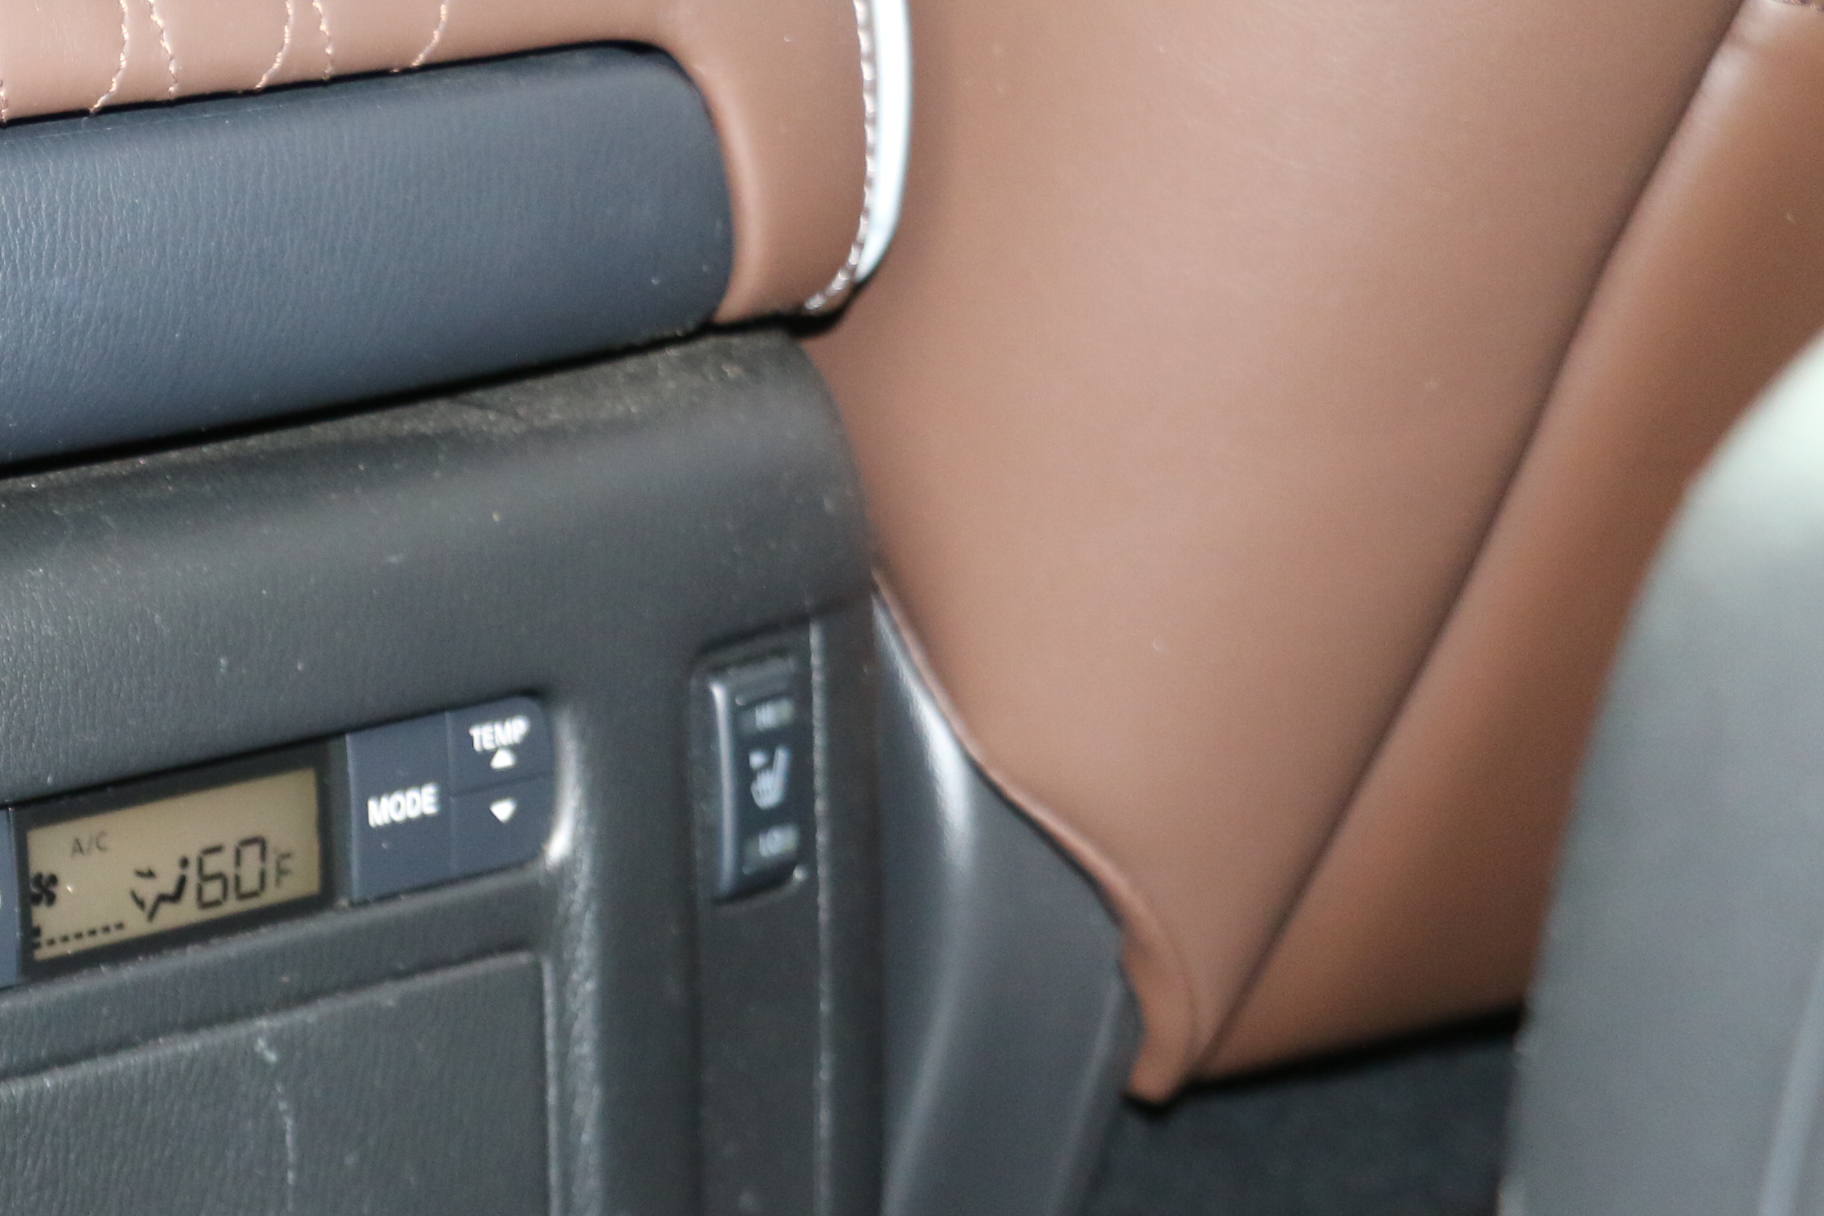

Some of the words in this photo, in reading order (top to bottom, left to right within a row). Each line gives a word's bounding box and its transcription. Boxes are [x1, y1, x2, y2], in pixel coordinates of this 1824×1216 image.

[468, 715, 530, 752] TEMP
[367, 782, 439, 828] MODE
[70, 830, 108, 858] A/C
